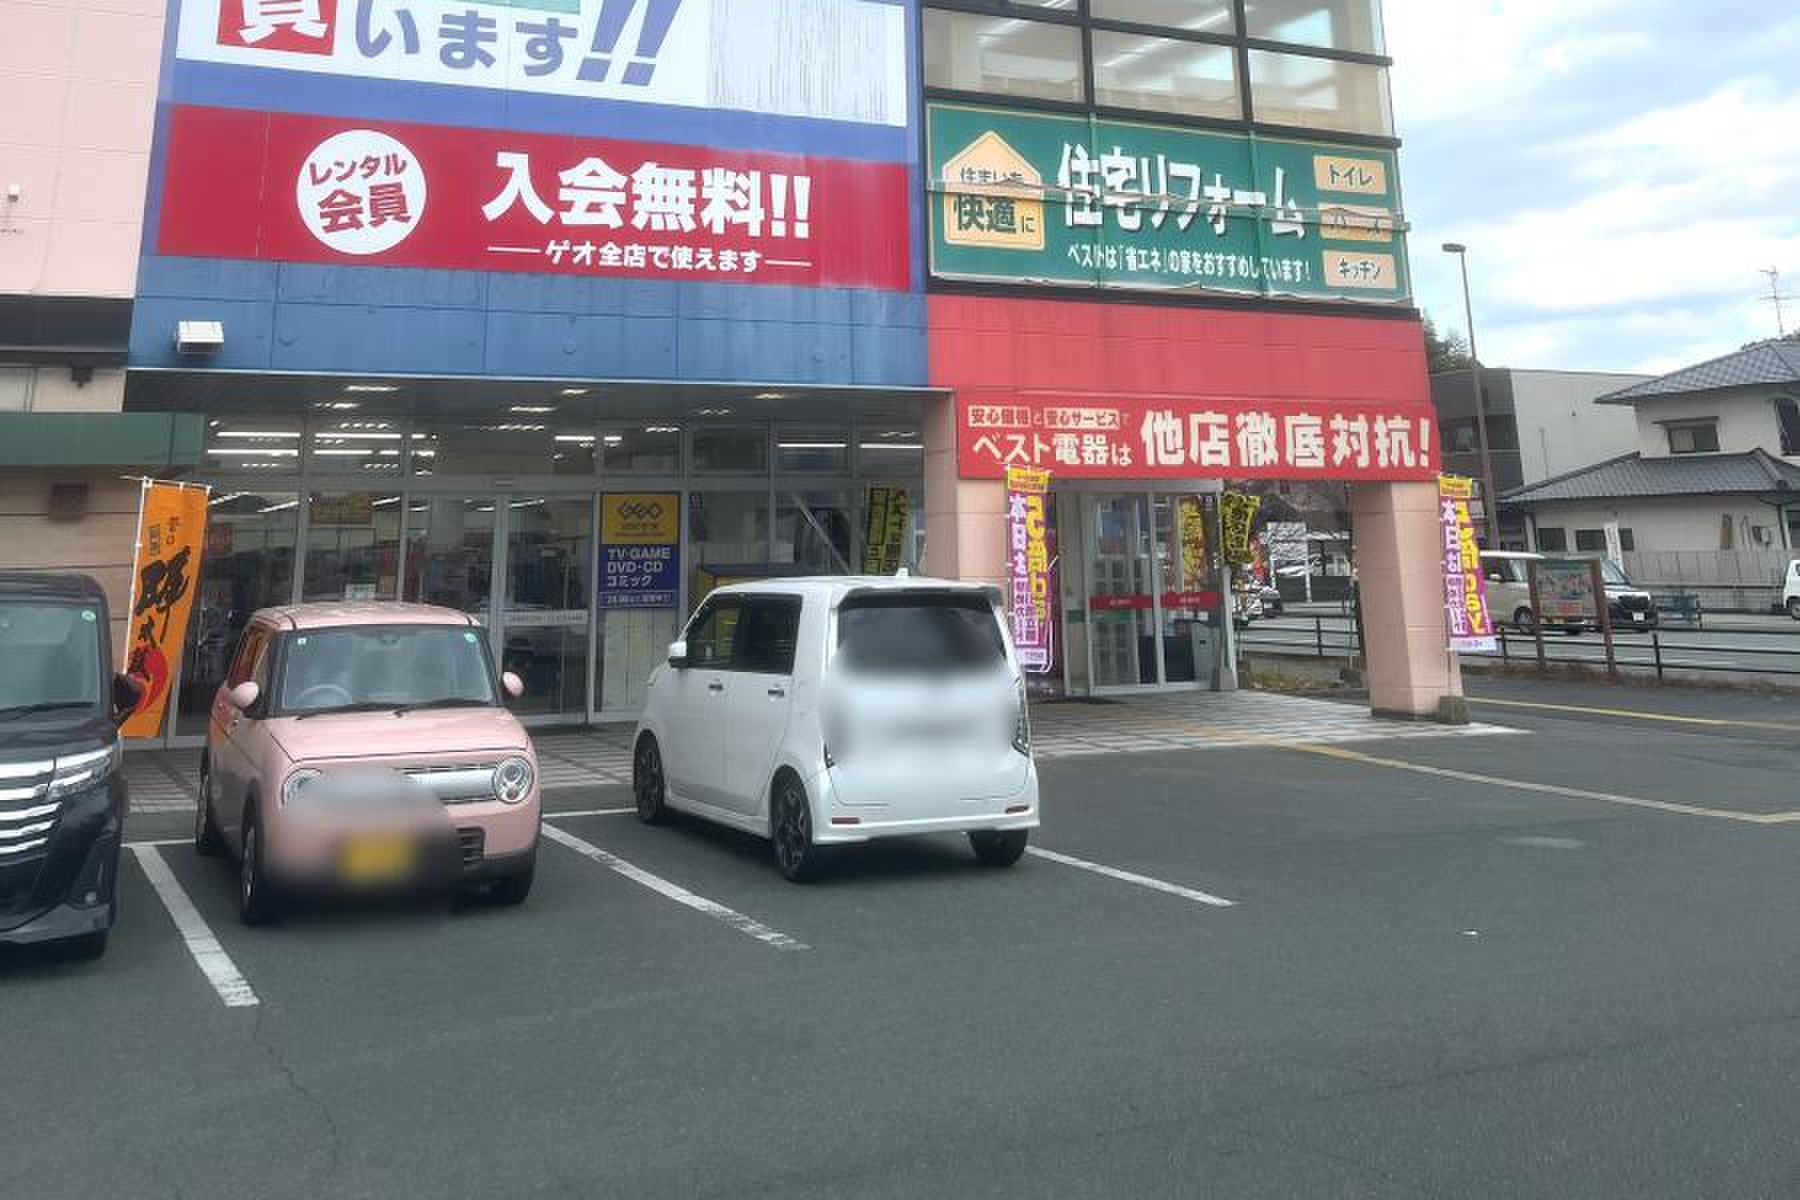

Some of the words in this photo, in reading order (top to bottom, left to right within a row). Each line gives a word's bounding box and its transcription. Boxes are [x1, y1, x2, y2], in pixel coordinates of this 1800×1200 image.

[308, 152, 407, 188] レンタル
[1057, 141, 1307, 239] 住宅リフォーム
[1328, 163, 1373, 186] トイレ
[318, 181, 413, 234] 会員
[481, 151, 812, 238] 入会無料!!
[544, 239, 767, 275] ゲオ全店で使えます
[972, 432, 1133, 467] ベスト電器は
[1140, 409, 1430, 469] 他店徹底対抗!
